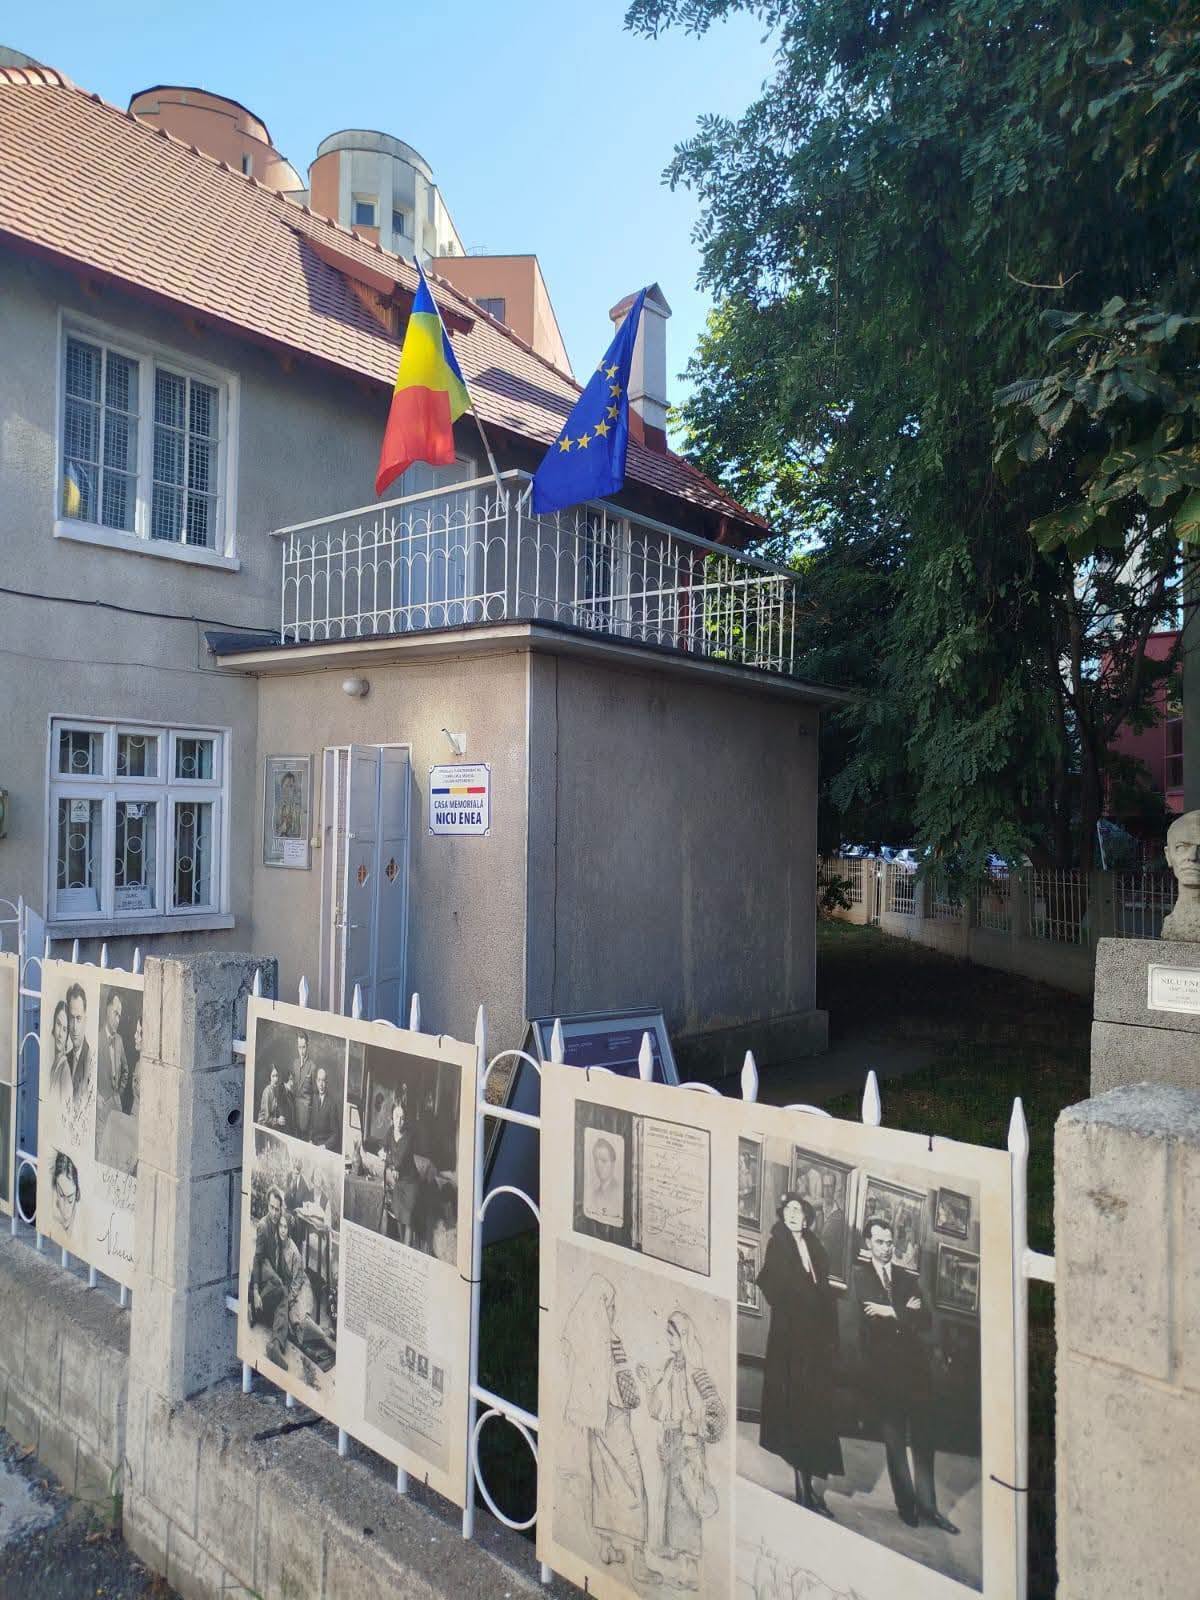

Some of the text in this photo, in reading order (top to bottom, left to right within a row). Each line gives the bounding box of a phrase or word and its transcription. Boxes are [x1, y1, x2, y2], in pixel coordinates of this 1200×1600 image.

[434, 800, 448, 809] CASA
[435, 812, 482, 825] NICU ENEA
